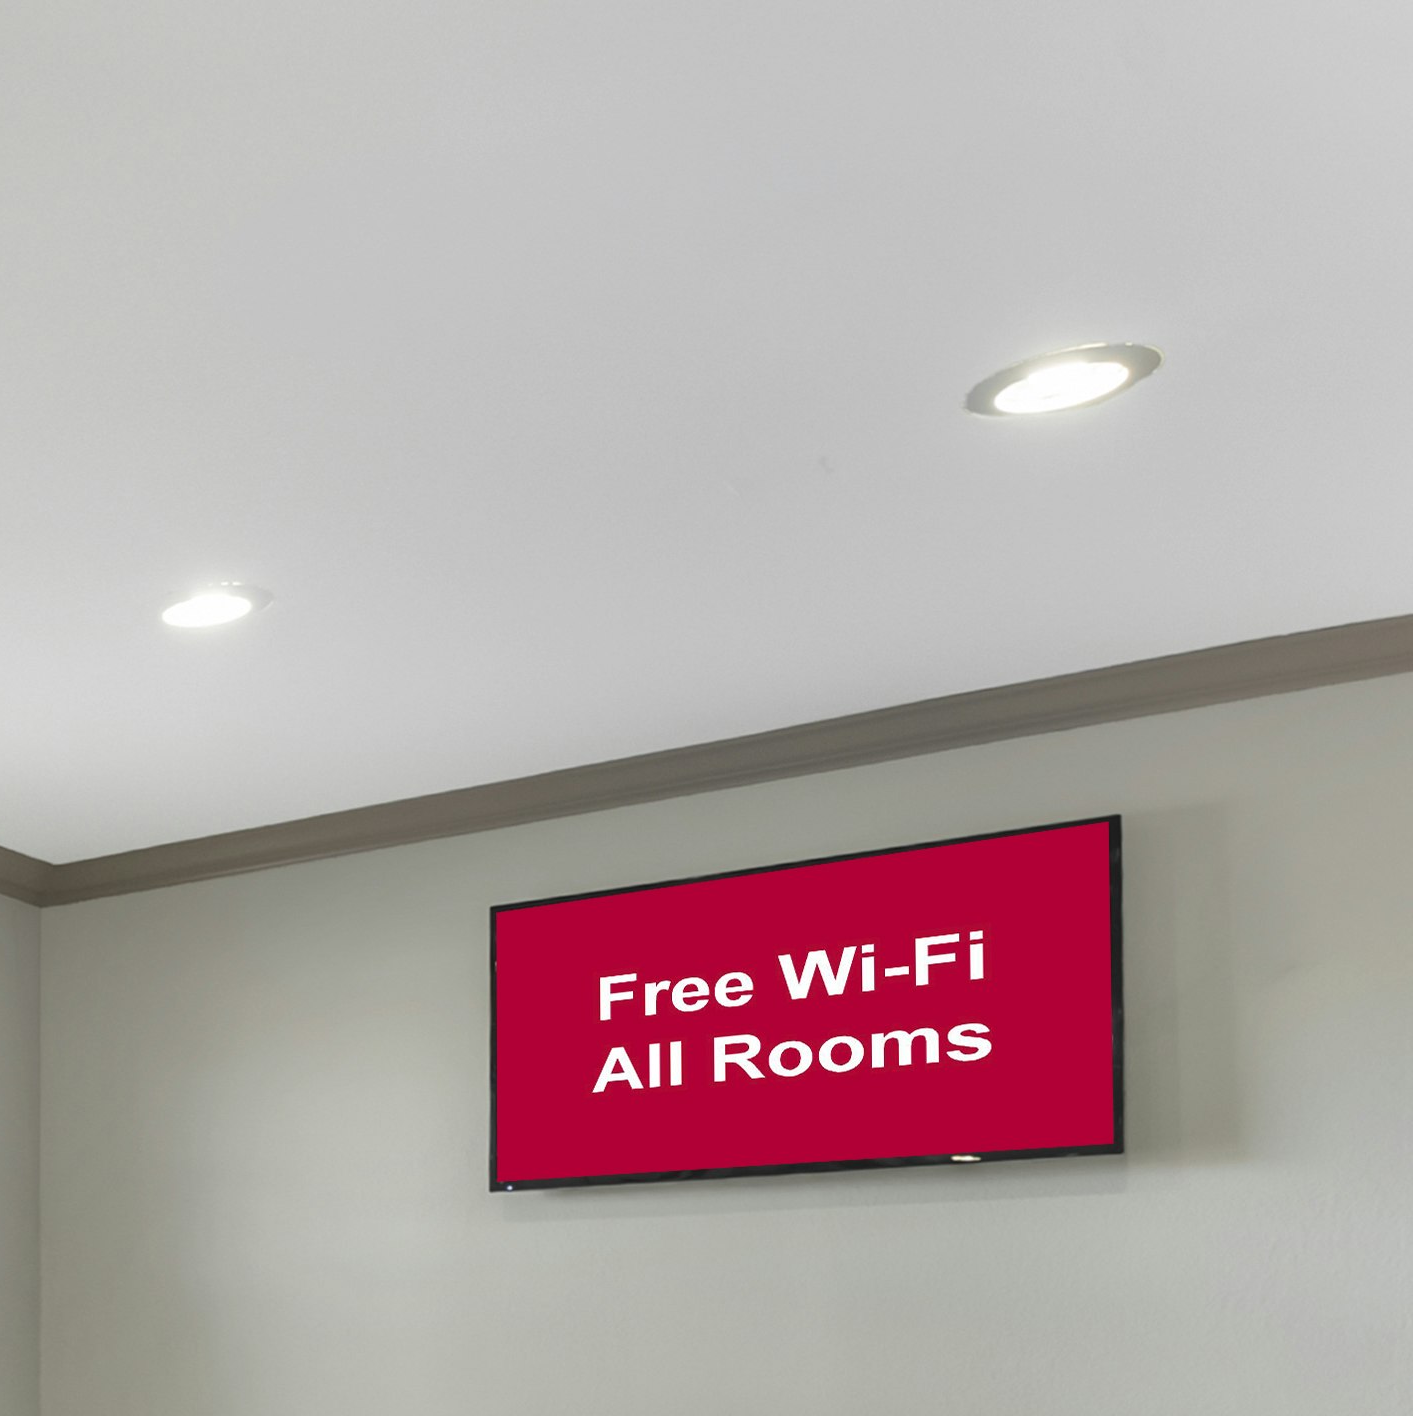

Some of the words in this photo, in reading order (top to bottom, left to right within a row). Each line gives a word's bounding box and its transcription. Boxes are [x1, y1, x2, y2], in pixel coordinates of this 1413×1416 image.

[598, 971, 755, 1021] Free
[778, 930, 985, 1000] Wi-Fi
[591, 1040, 684, 1093] All
[713, 1022, 993, 1081] Rooms
